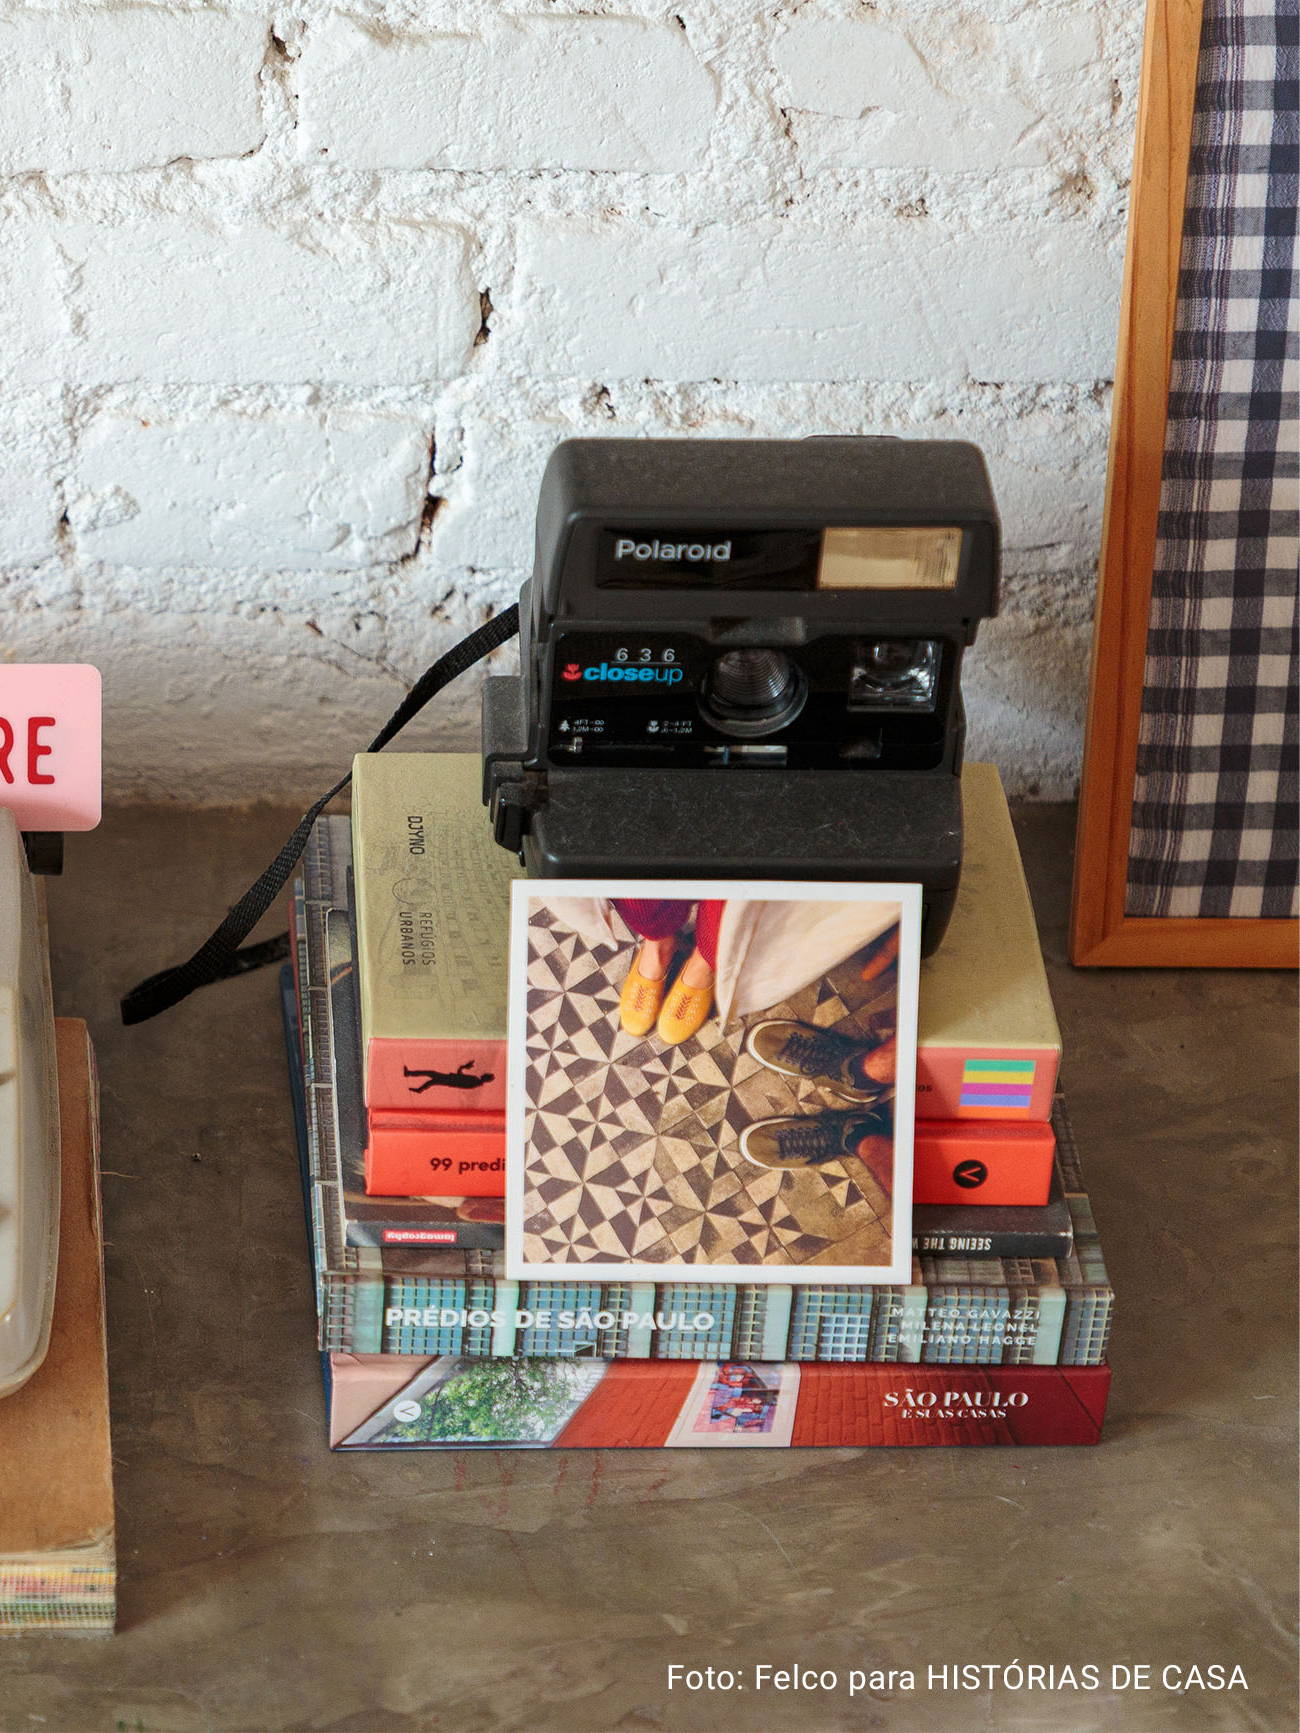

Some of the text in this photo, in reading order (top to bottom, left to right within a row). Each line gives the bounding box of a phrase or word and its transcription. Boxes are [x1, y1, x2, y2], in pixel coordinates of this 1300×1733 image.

[614, 539, 732, 562] Polaroid
[583, 662, 684, 686] closeup
[406, 815, 425, 856] DJYNO
[398, 911, 416, 966] URBANOS
[430, 1157, 506, 1175] 99 predi
[923, 1237, 945, 1250] THE
[949, 1236, 993, 1251] SEEING
[385, 1305, 716, 1332] PRÉDIOS DE SÃO PAULO
[891, 1306, 1041, 1320] MATTEO GAVAZZI
[900, 1319, 1040, 1334] MILENA LEONEL
[887, 1333, 1037, 1347] EMILIANO HAGGE
[883, 1388, 1030, 1409] SÃO PAULO
[901, 1408, 1008, 1420] E SUAS CASAS
